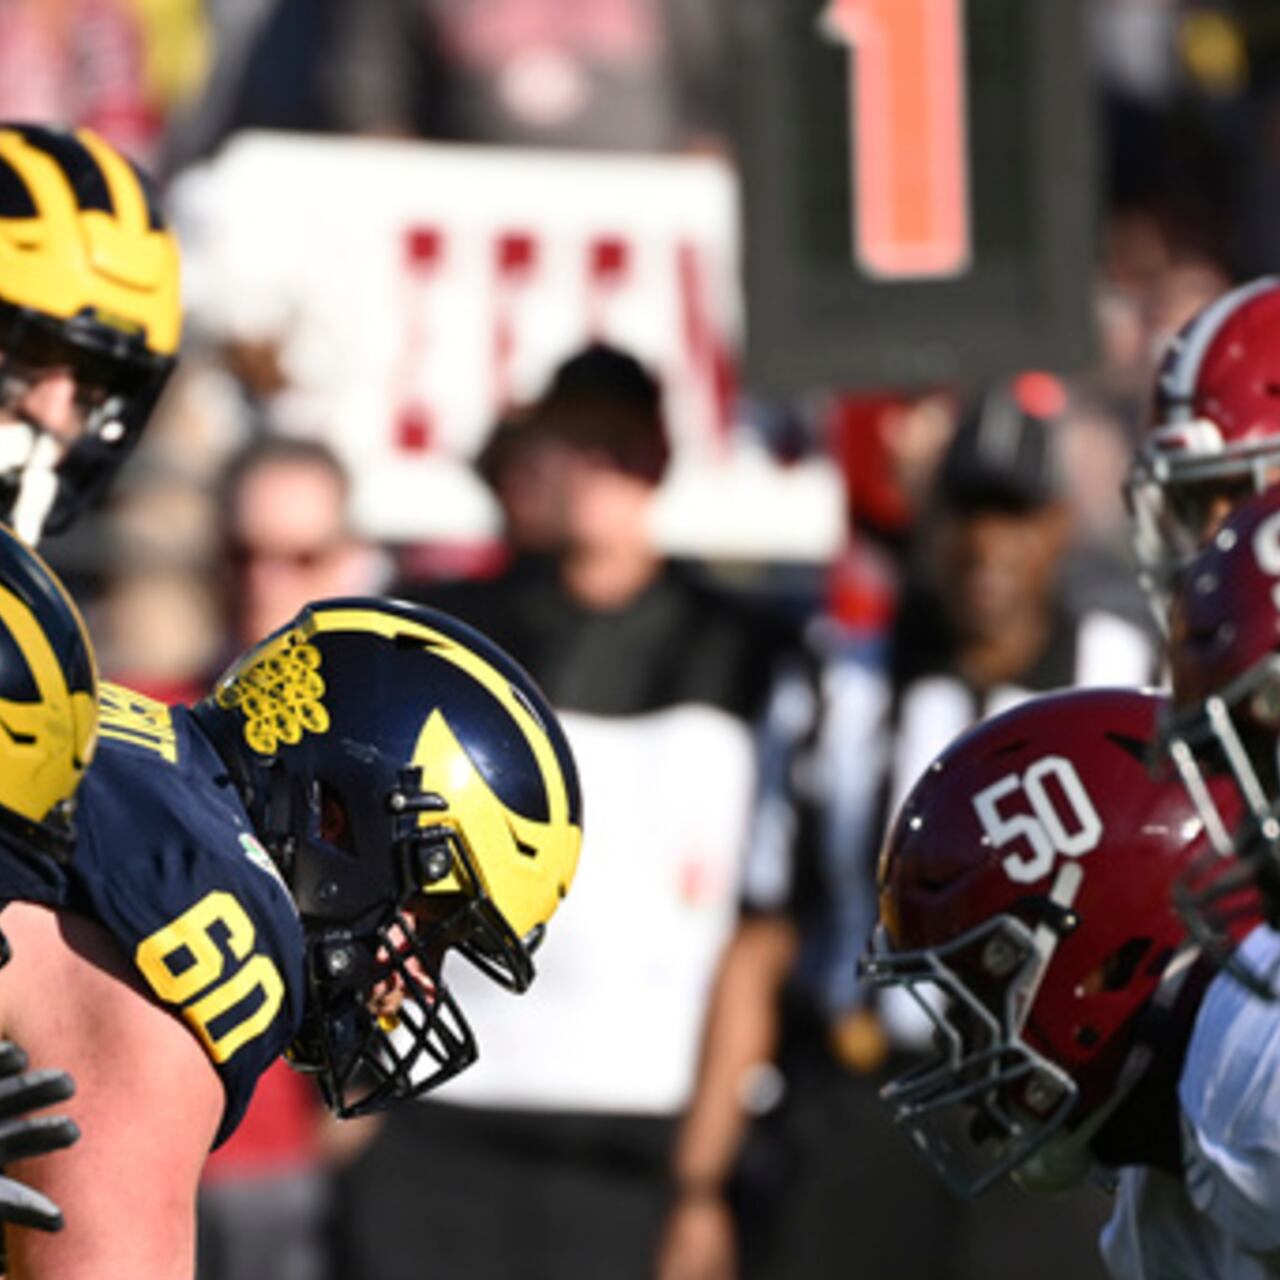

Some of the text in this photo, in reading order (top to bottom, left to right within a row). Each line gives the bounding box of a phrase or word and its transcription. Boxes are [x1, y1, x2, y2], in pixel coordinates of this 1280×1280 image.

[818, 0, 970, 278] 1
[972, 755, 1103, 885] 50
[135, 889, 285, 1064] 60
